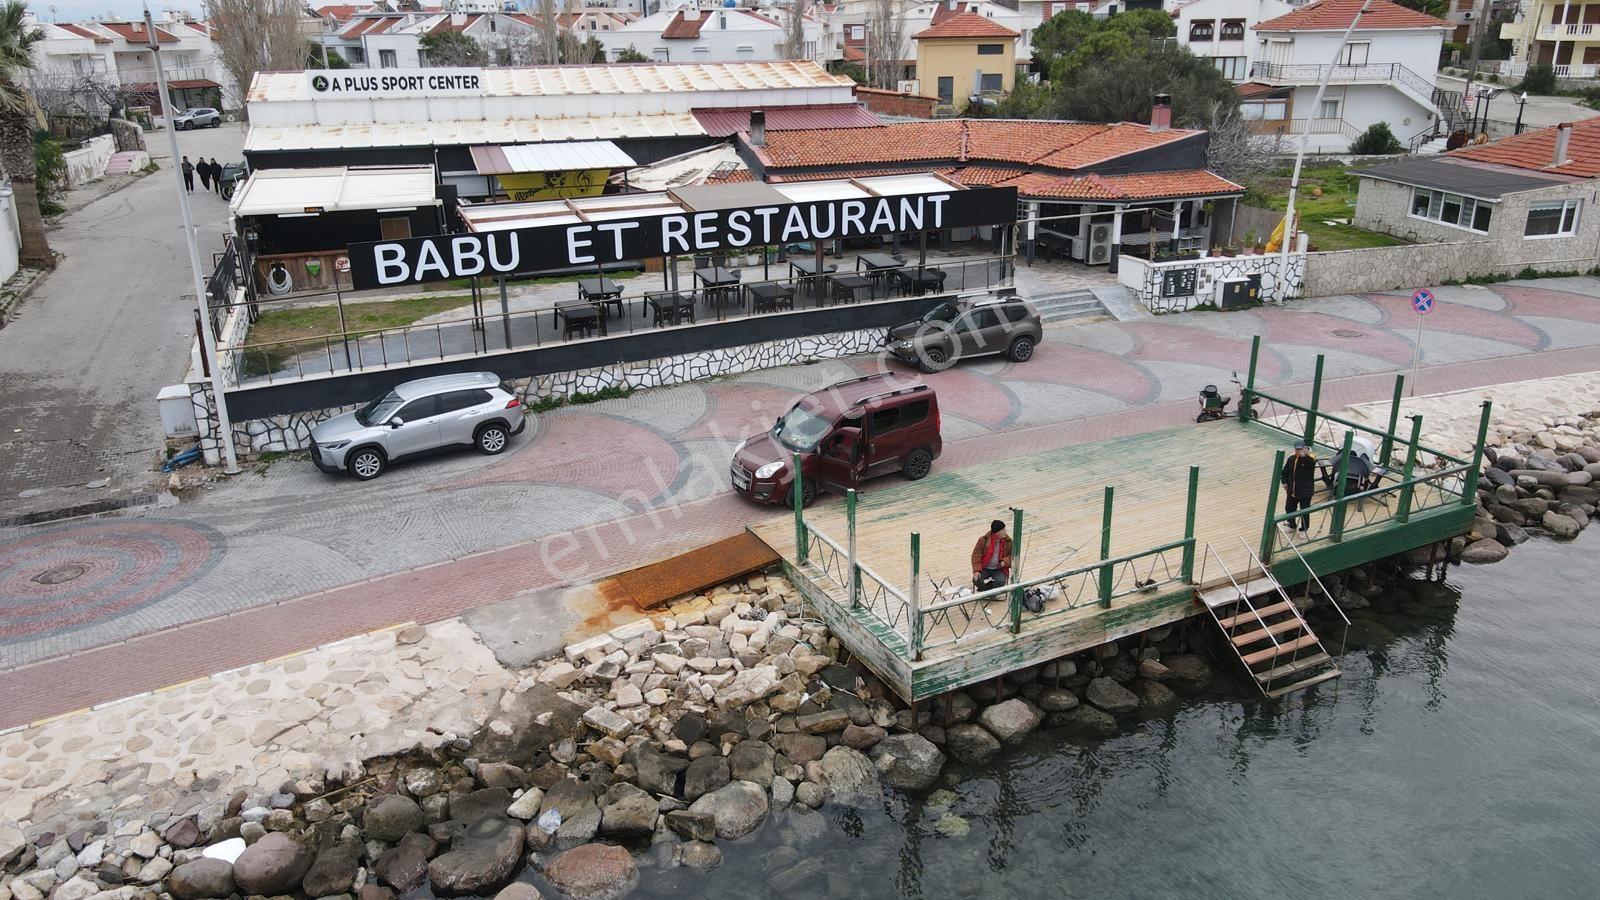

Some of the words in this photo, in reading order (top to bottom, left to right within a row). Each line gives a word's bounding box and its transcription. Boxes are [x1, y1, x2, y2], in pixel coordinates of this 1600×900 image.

[332, 77, 342, 92] A
[345, 76, 378, 91] PLUS
[382, 76, 424, 91] SPORT
[428, 75, 480, 90] CENTER
[373, 231, 520, 285] BABU
[566, 221, 640, 265] ET
[661, 194, 950, 253] RESTAURANT
